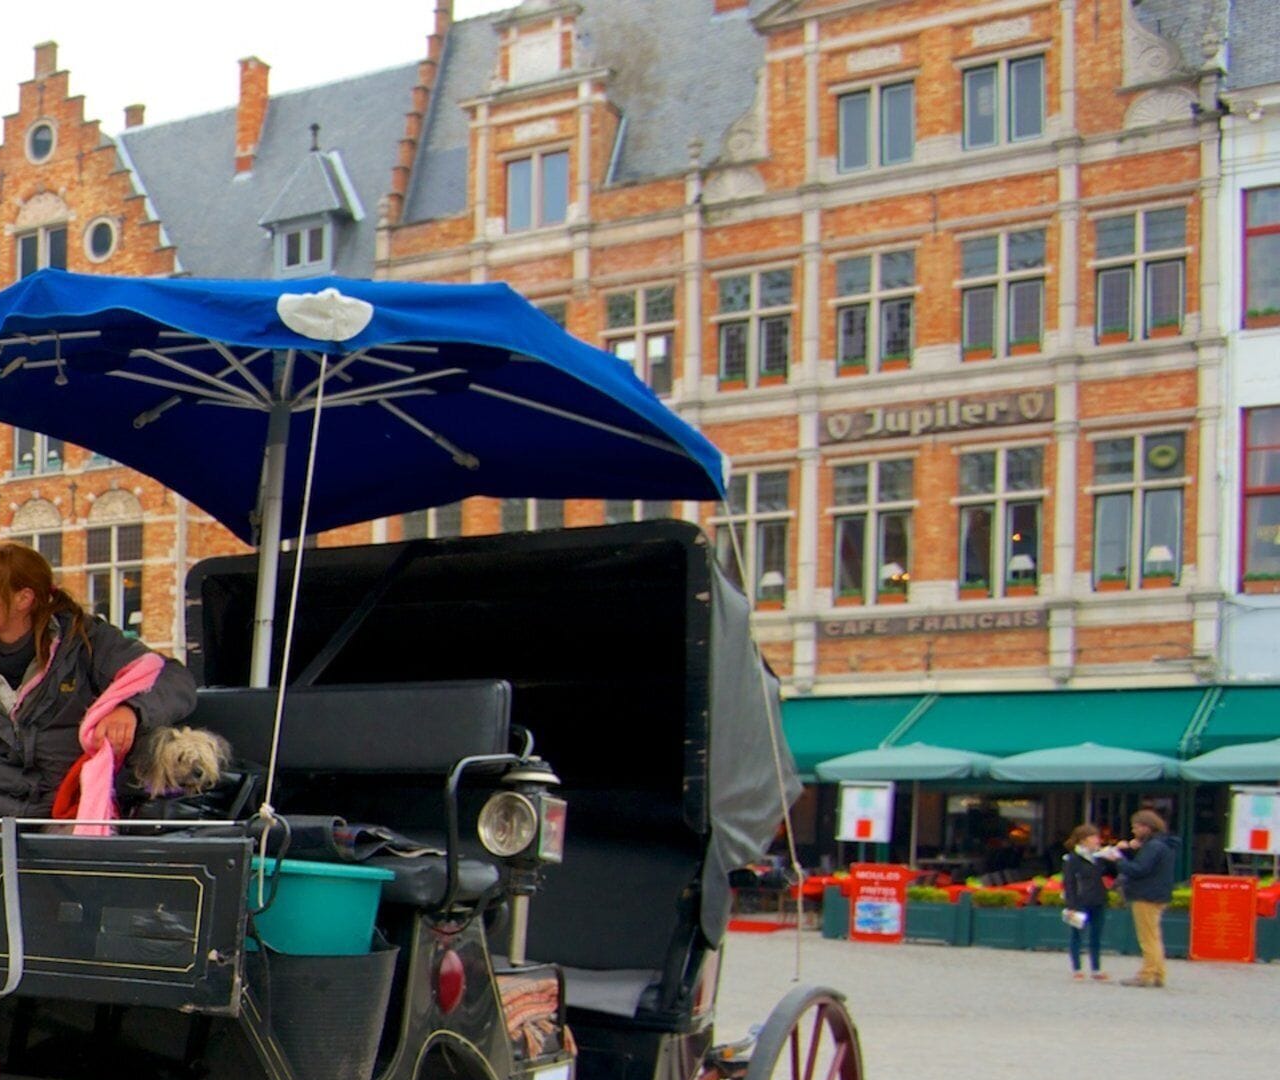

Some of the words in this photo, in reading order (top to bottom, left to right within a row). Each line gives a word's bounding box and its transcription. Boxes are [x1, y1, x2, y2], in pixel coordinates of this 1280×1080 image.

[864, 399, 1008, 437] Jupiler
[824, 618, 889, 636] CAFE
[906, 610, 1039, 632] FRANCAIS
